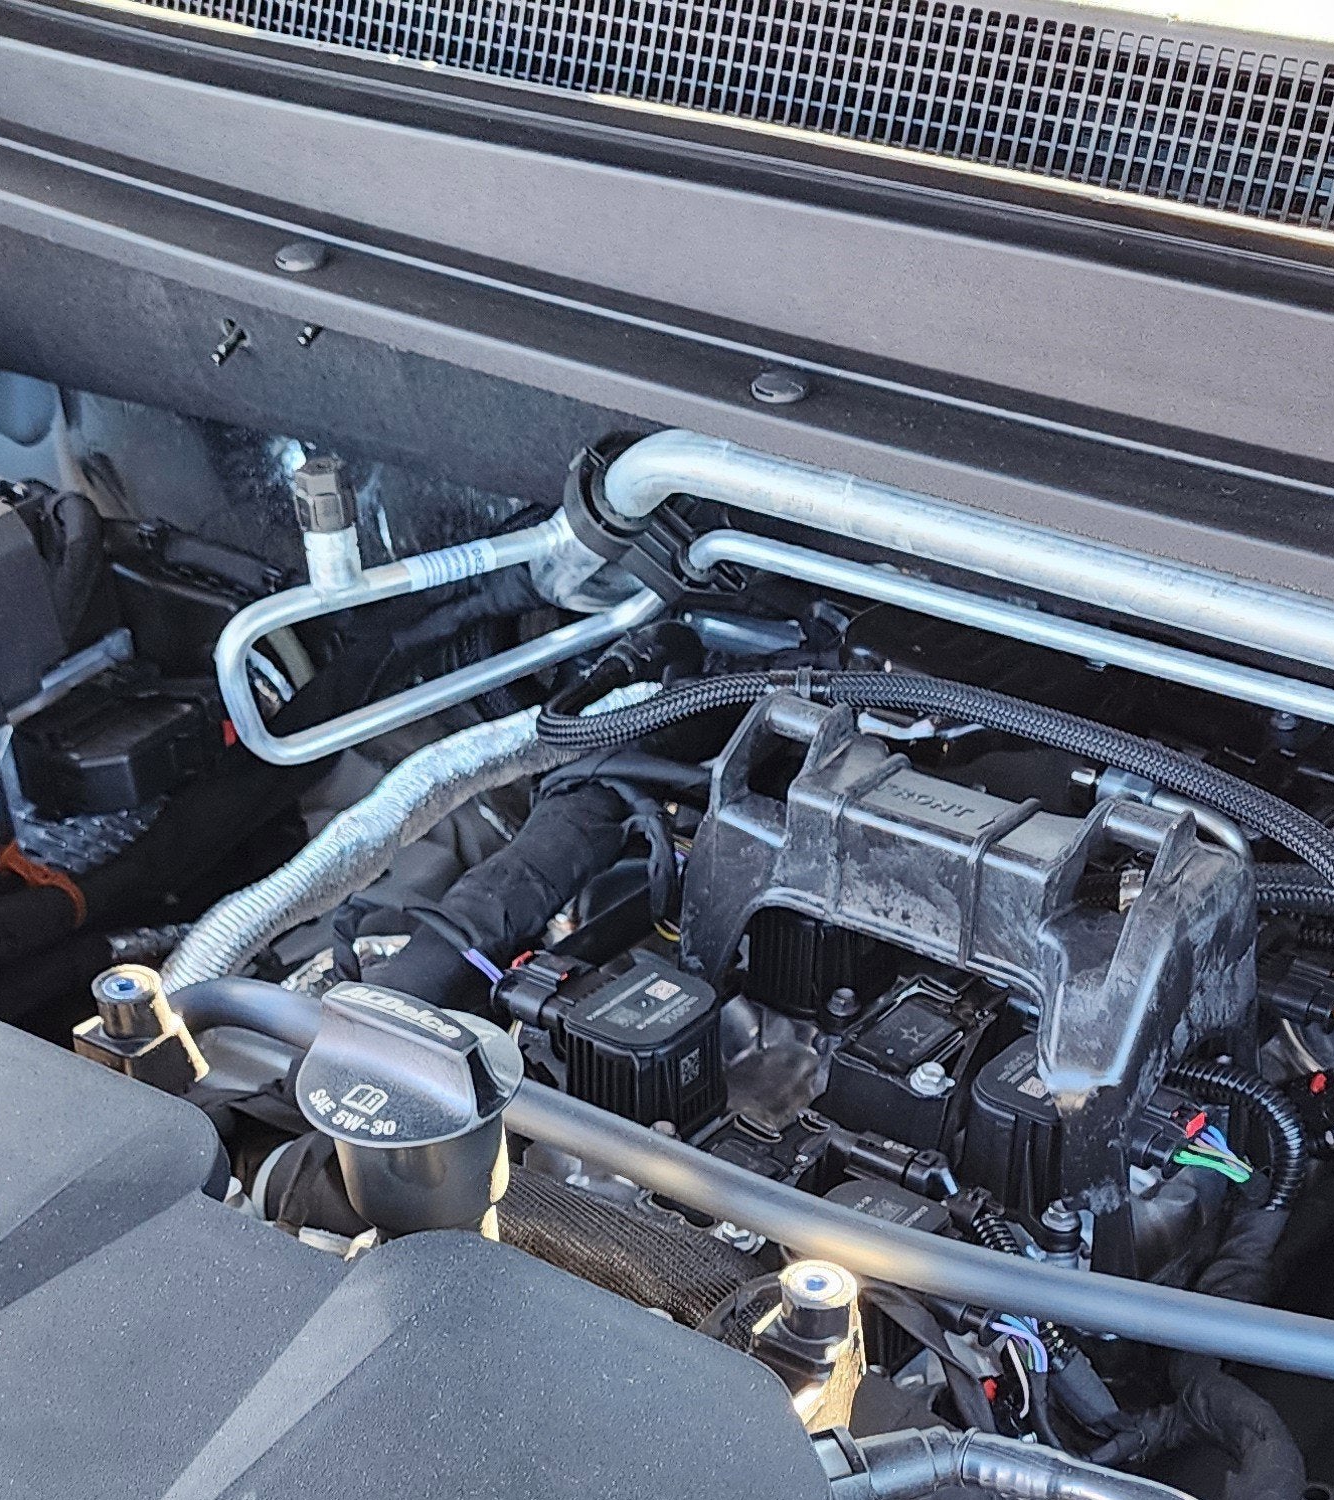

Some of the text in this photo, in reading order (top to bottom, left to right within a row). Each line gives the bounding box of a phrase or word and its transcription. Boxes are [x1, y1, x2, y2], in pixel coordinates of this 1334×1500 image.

[339, 987, 462, 1038] ACDelco
[308, 1088, 397, 1136] SAE 5W-30
